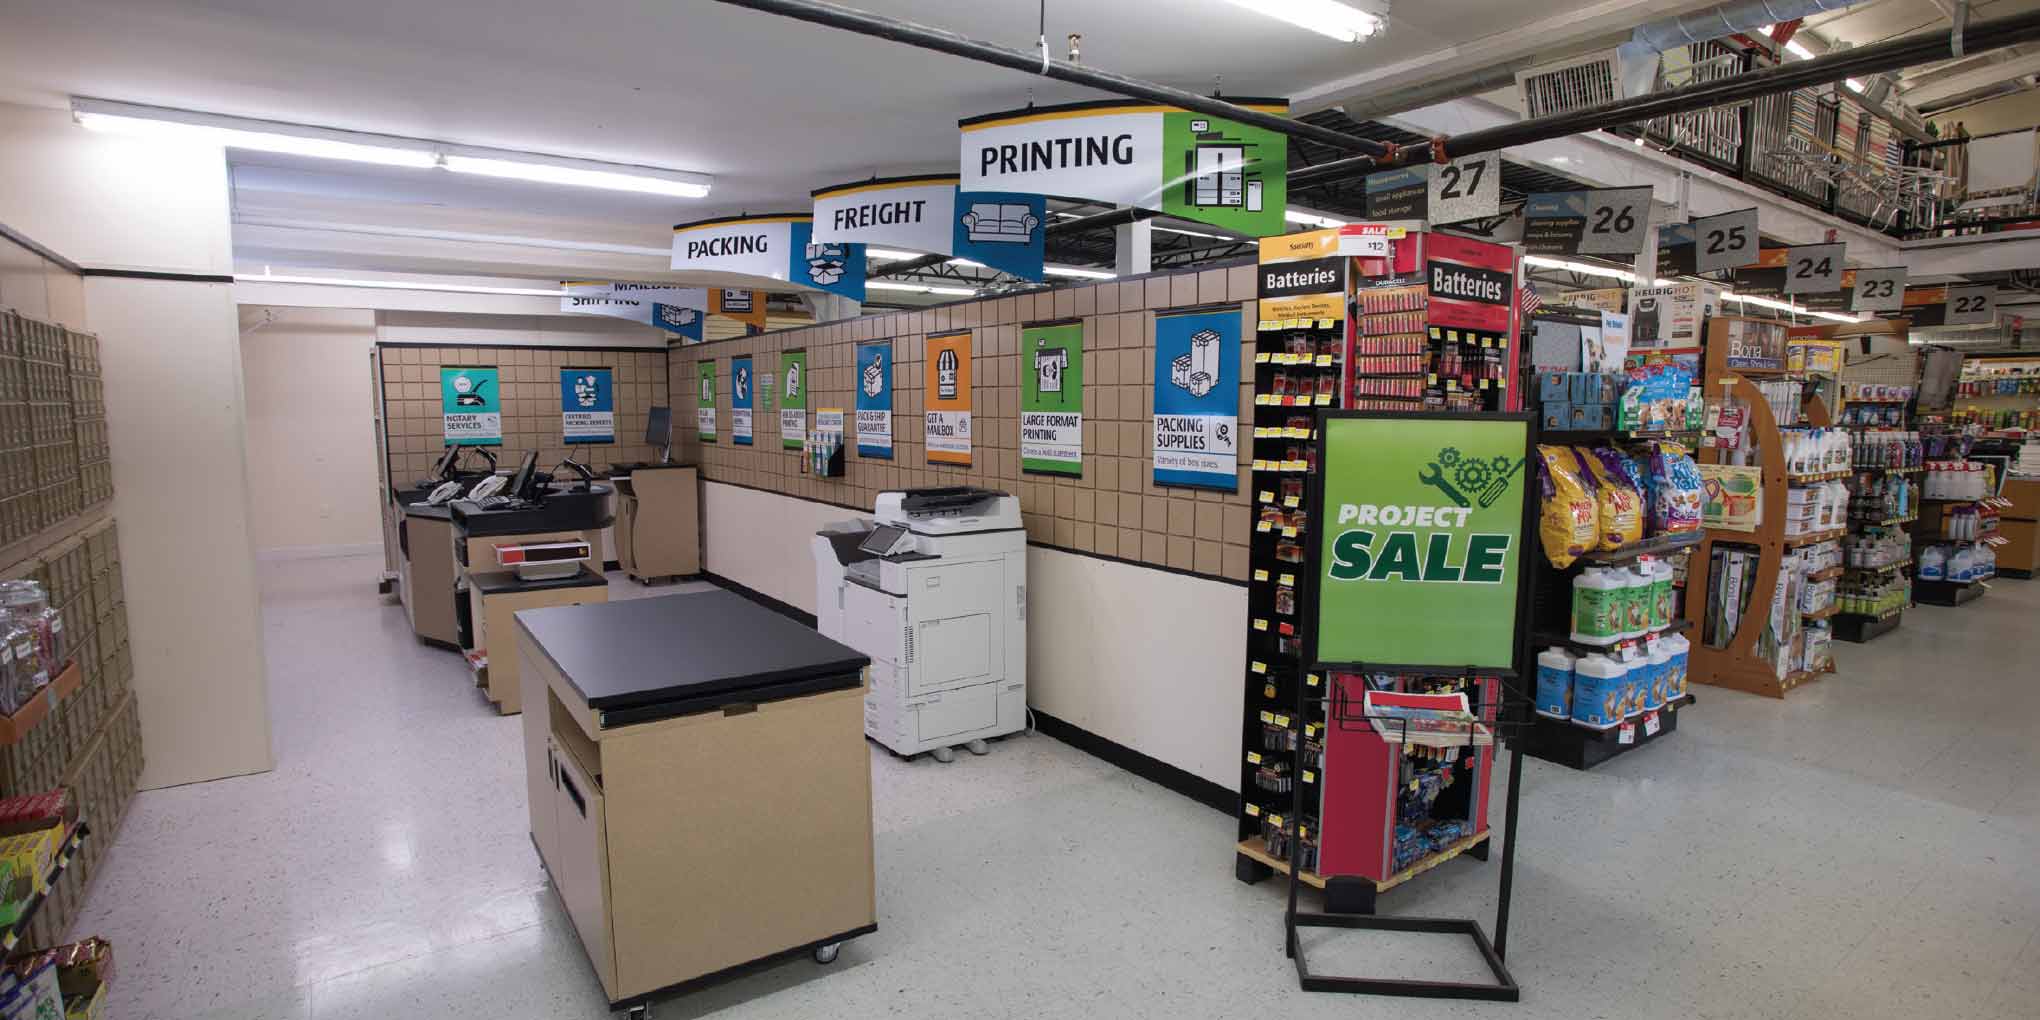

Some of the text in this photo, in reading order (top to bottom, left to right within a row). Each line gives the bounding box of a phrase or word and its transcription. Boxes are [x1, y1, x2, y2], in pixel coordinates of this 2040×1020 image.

[980, 134, 1134, 178] PRINTING
[1440, 159, 1487, 200] 27
[834, 201, 926, 231] FREIGHT
[1592, 205, 1635, 234] 26
[1362, 226, 1387, 235] SALE
[688, 235, 768, 259] PACKING
[1368, 242, 1384, 251] $12
[1706, 226, 1746, 254] 25
[1799, 256, 1833, 279] 24
[1267, 267, 1336, 289] Batteries
[1433, 267, 1502, 300] Batteries
[1635, 285, 1696, 297] KEURIG HOT
[1861, 279, 1895, 298] 23
[1954, 295, 1987, 313] 22
[1730, 340, 1761, 358] Bona
[448, 422, 482, 430] SERVICES
[927, 413, 944, 424] GET A
[1023, 414, 1079, 428] LARGE FORMAT
[1157, 417, 1204, 433] PACKING
[927, 424, 954, 436] MAILBOX
[1023, 429, 1057, 441] PRINTING
[1157, 433, 1206, 450] SUPPLIES
[1338, 503, 1473, 528] PROJECT
[1328, 528, 1512, 584] SALE
